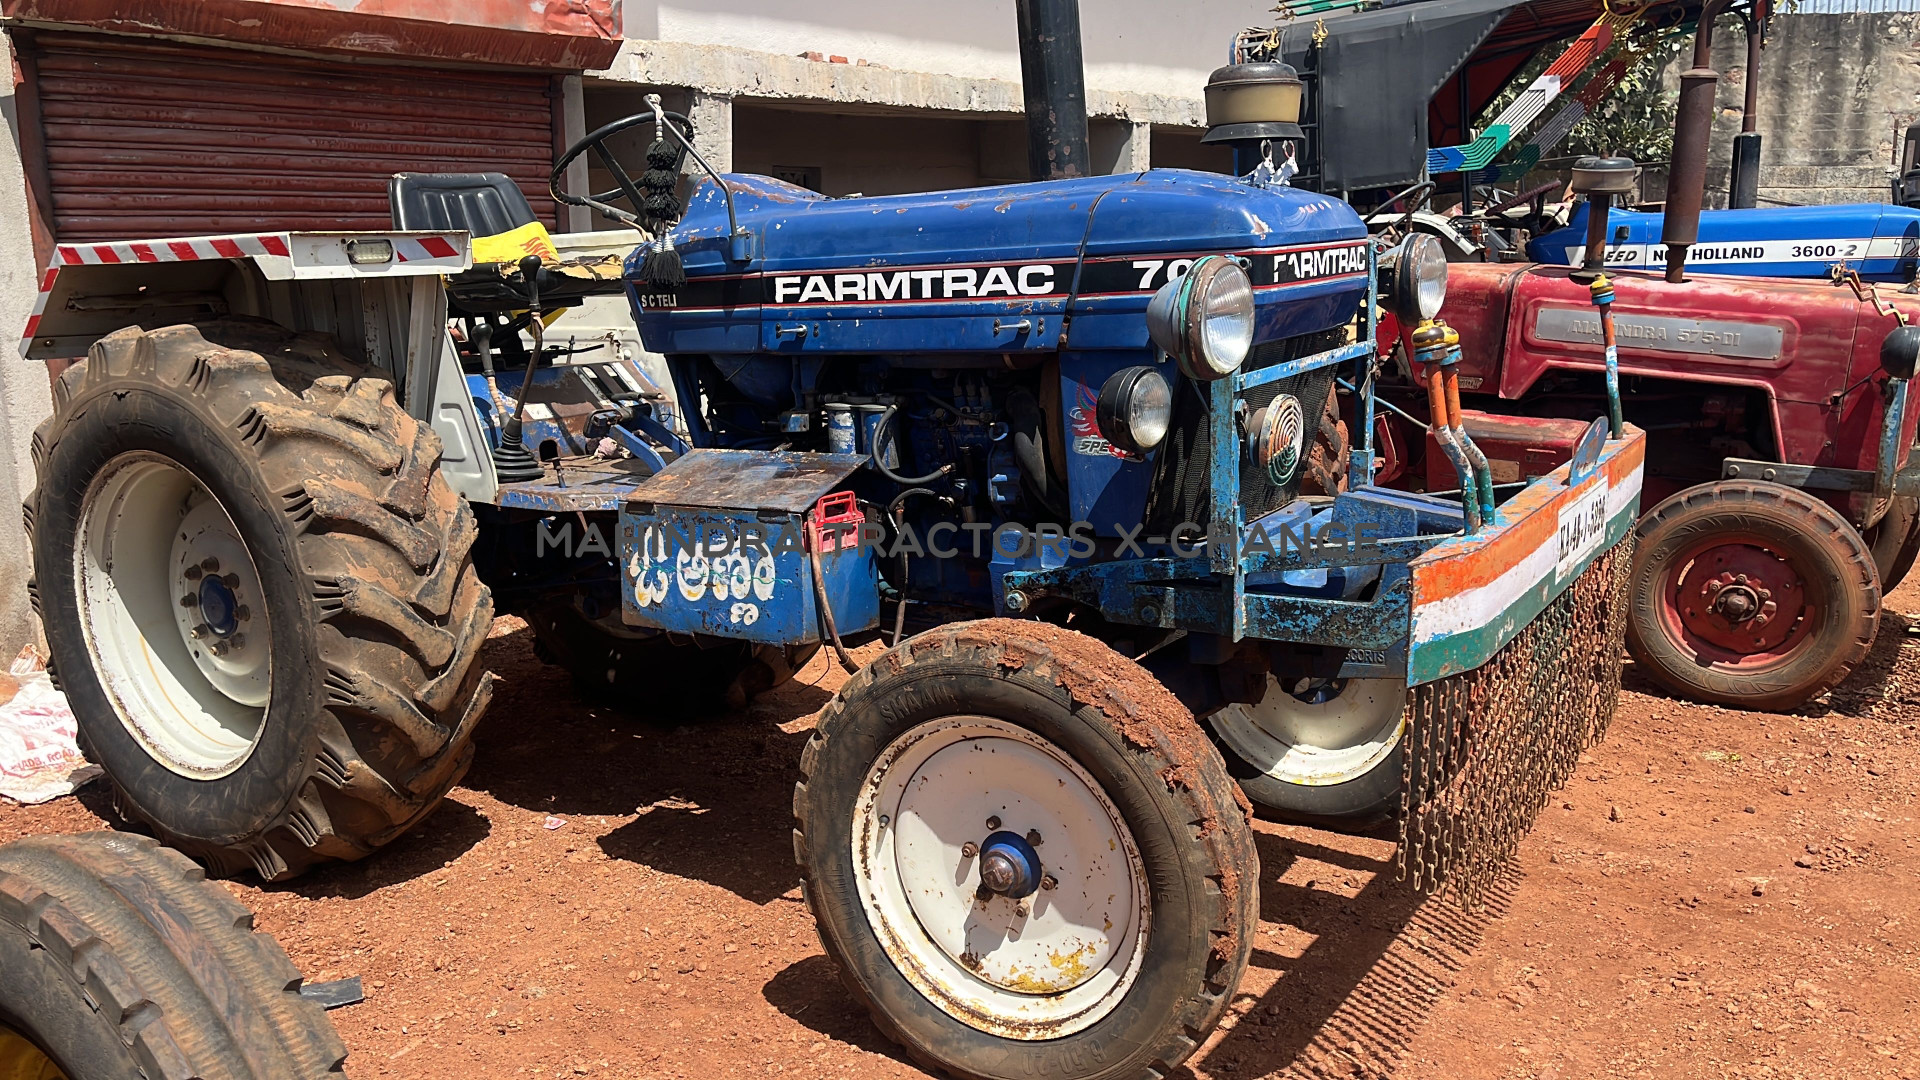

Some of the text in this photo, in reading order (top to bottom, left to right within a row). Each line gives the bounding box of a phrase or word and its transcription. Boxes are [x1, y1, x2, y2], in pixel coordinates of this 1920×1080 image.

[1273, 245, 1366, 283] FARMTRAC
[1692, 247, 1765, 261] HOLLAND
[775, 264, 1055, 304] FARMTRAC
[641, 293, 677, 308] S C TELI
[1570, 319, 1741, 347] MAINDRA 575-DI
[47, 748, 75, 763] ROAD
